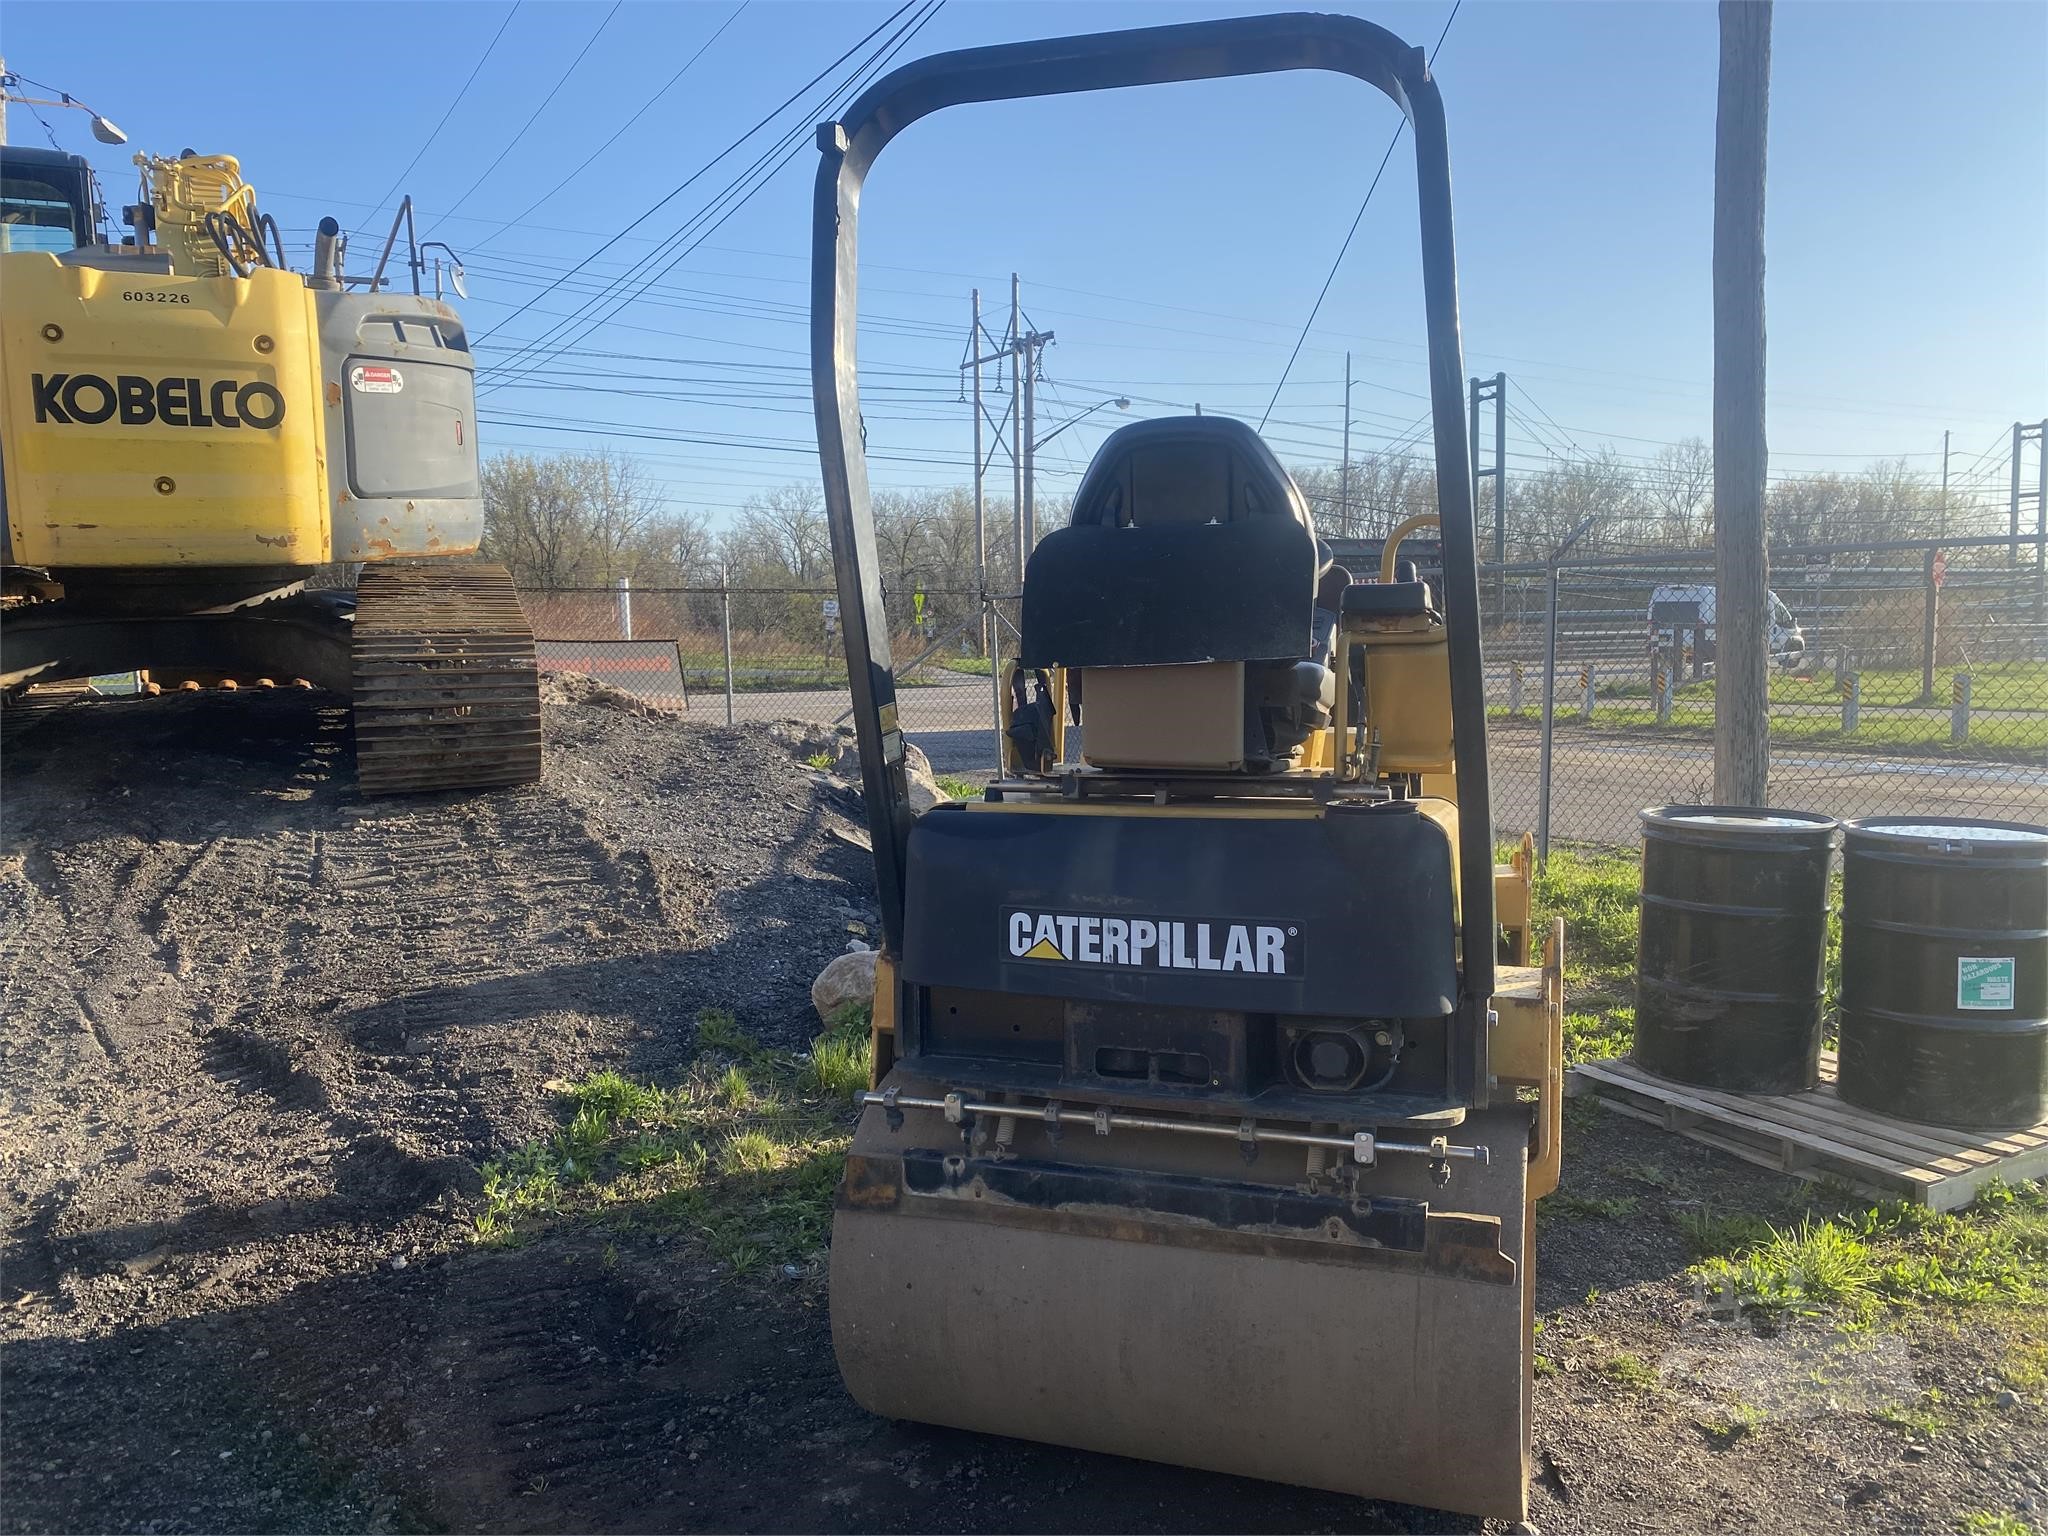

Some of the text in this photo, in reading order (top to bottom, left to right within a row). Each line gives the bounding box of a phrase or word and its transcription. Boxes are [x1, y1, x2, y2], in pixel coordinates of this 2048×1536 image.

[123, 291, 190, 304] 603226
[31, 373, 286, 430] KOBELCO
[1962, 963, 1979, 974] NON
[1962, 963, 2002, 982] HAZARDOUS
